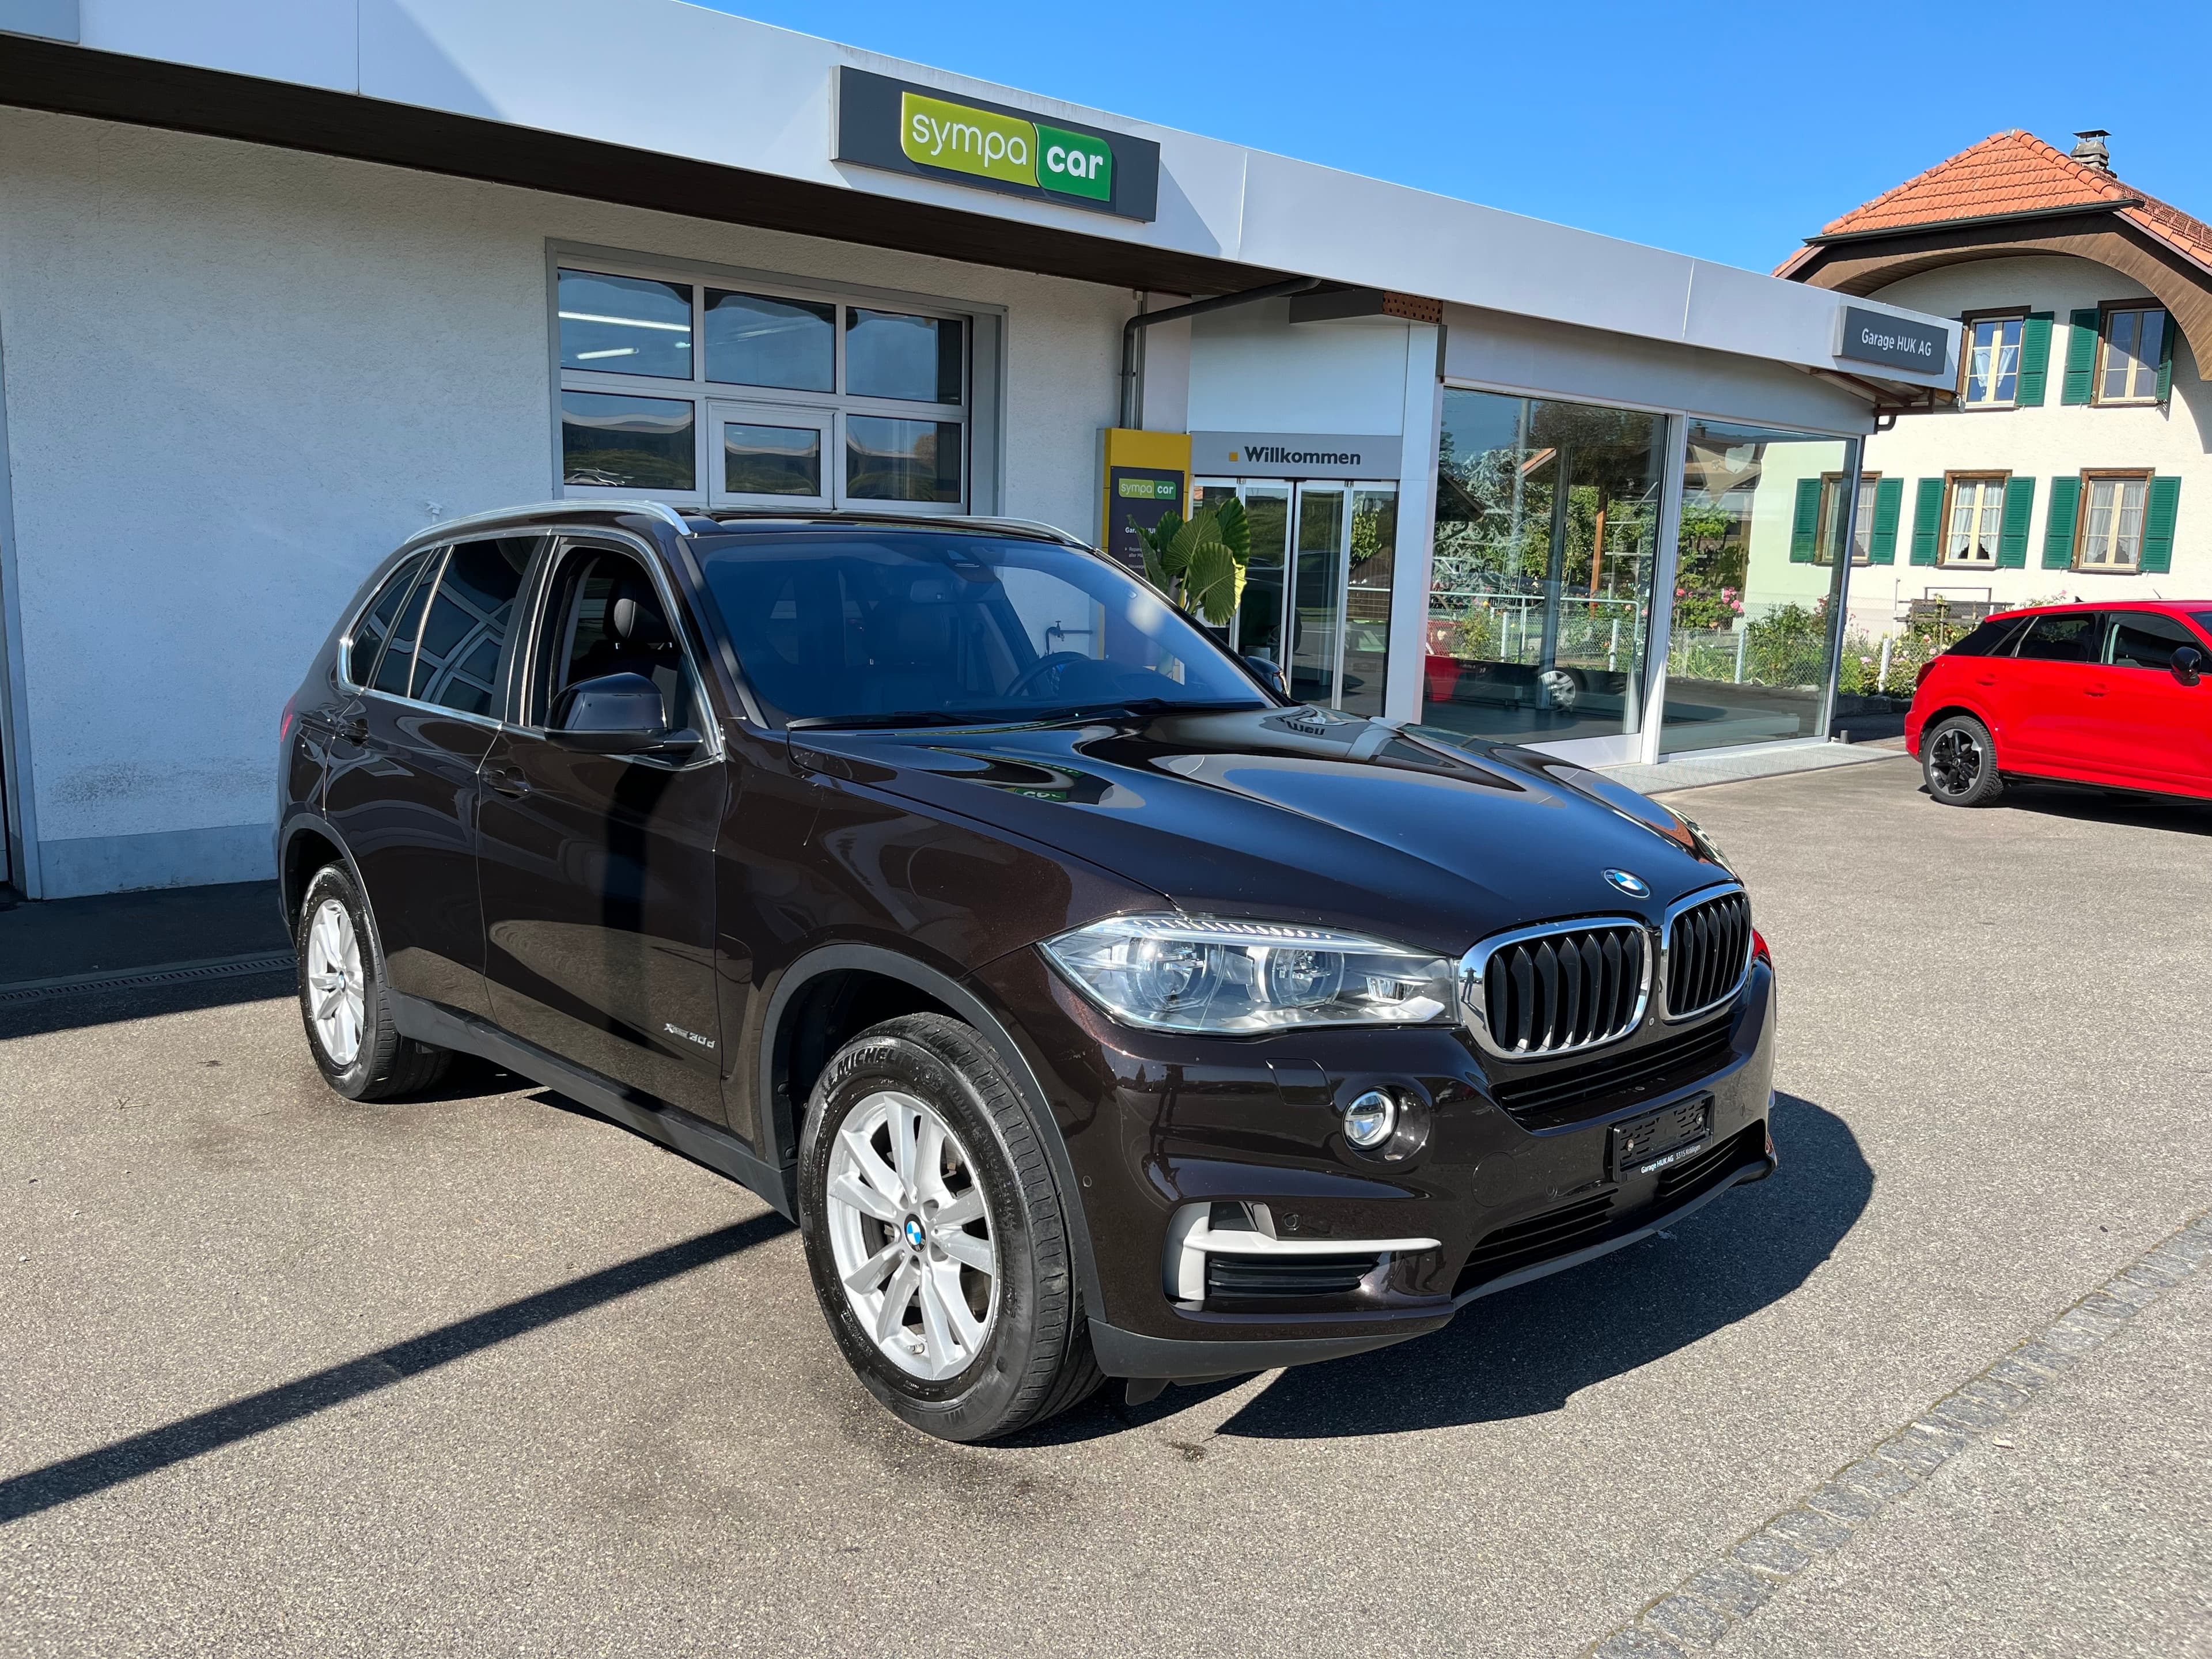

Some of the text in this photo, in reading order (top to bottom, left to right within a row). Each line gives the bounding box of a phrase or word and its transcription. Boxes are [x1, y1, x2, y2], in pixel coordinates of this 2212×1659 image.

[912, 114, 1103, 180] sympa car
[1861, 327, 1931, 357] Garage HUK AG
[1244, 446, 1361, 465] Willkommen
[1121, 483, 1174, 496] sympa car
[1641, 1162, 1657, 1174] Garage
[1657, 1157, 1668, 1168] HUK
[1666, 1155, 1674, 1163] AG
